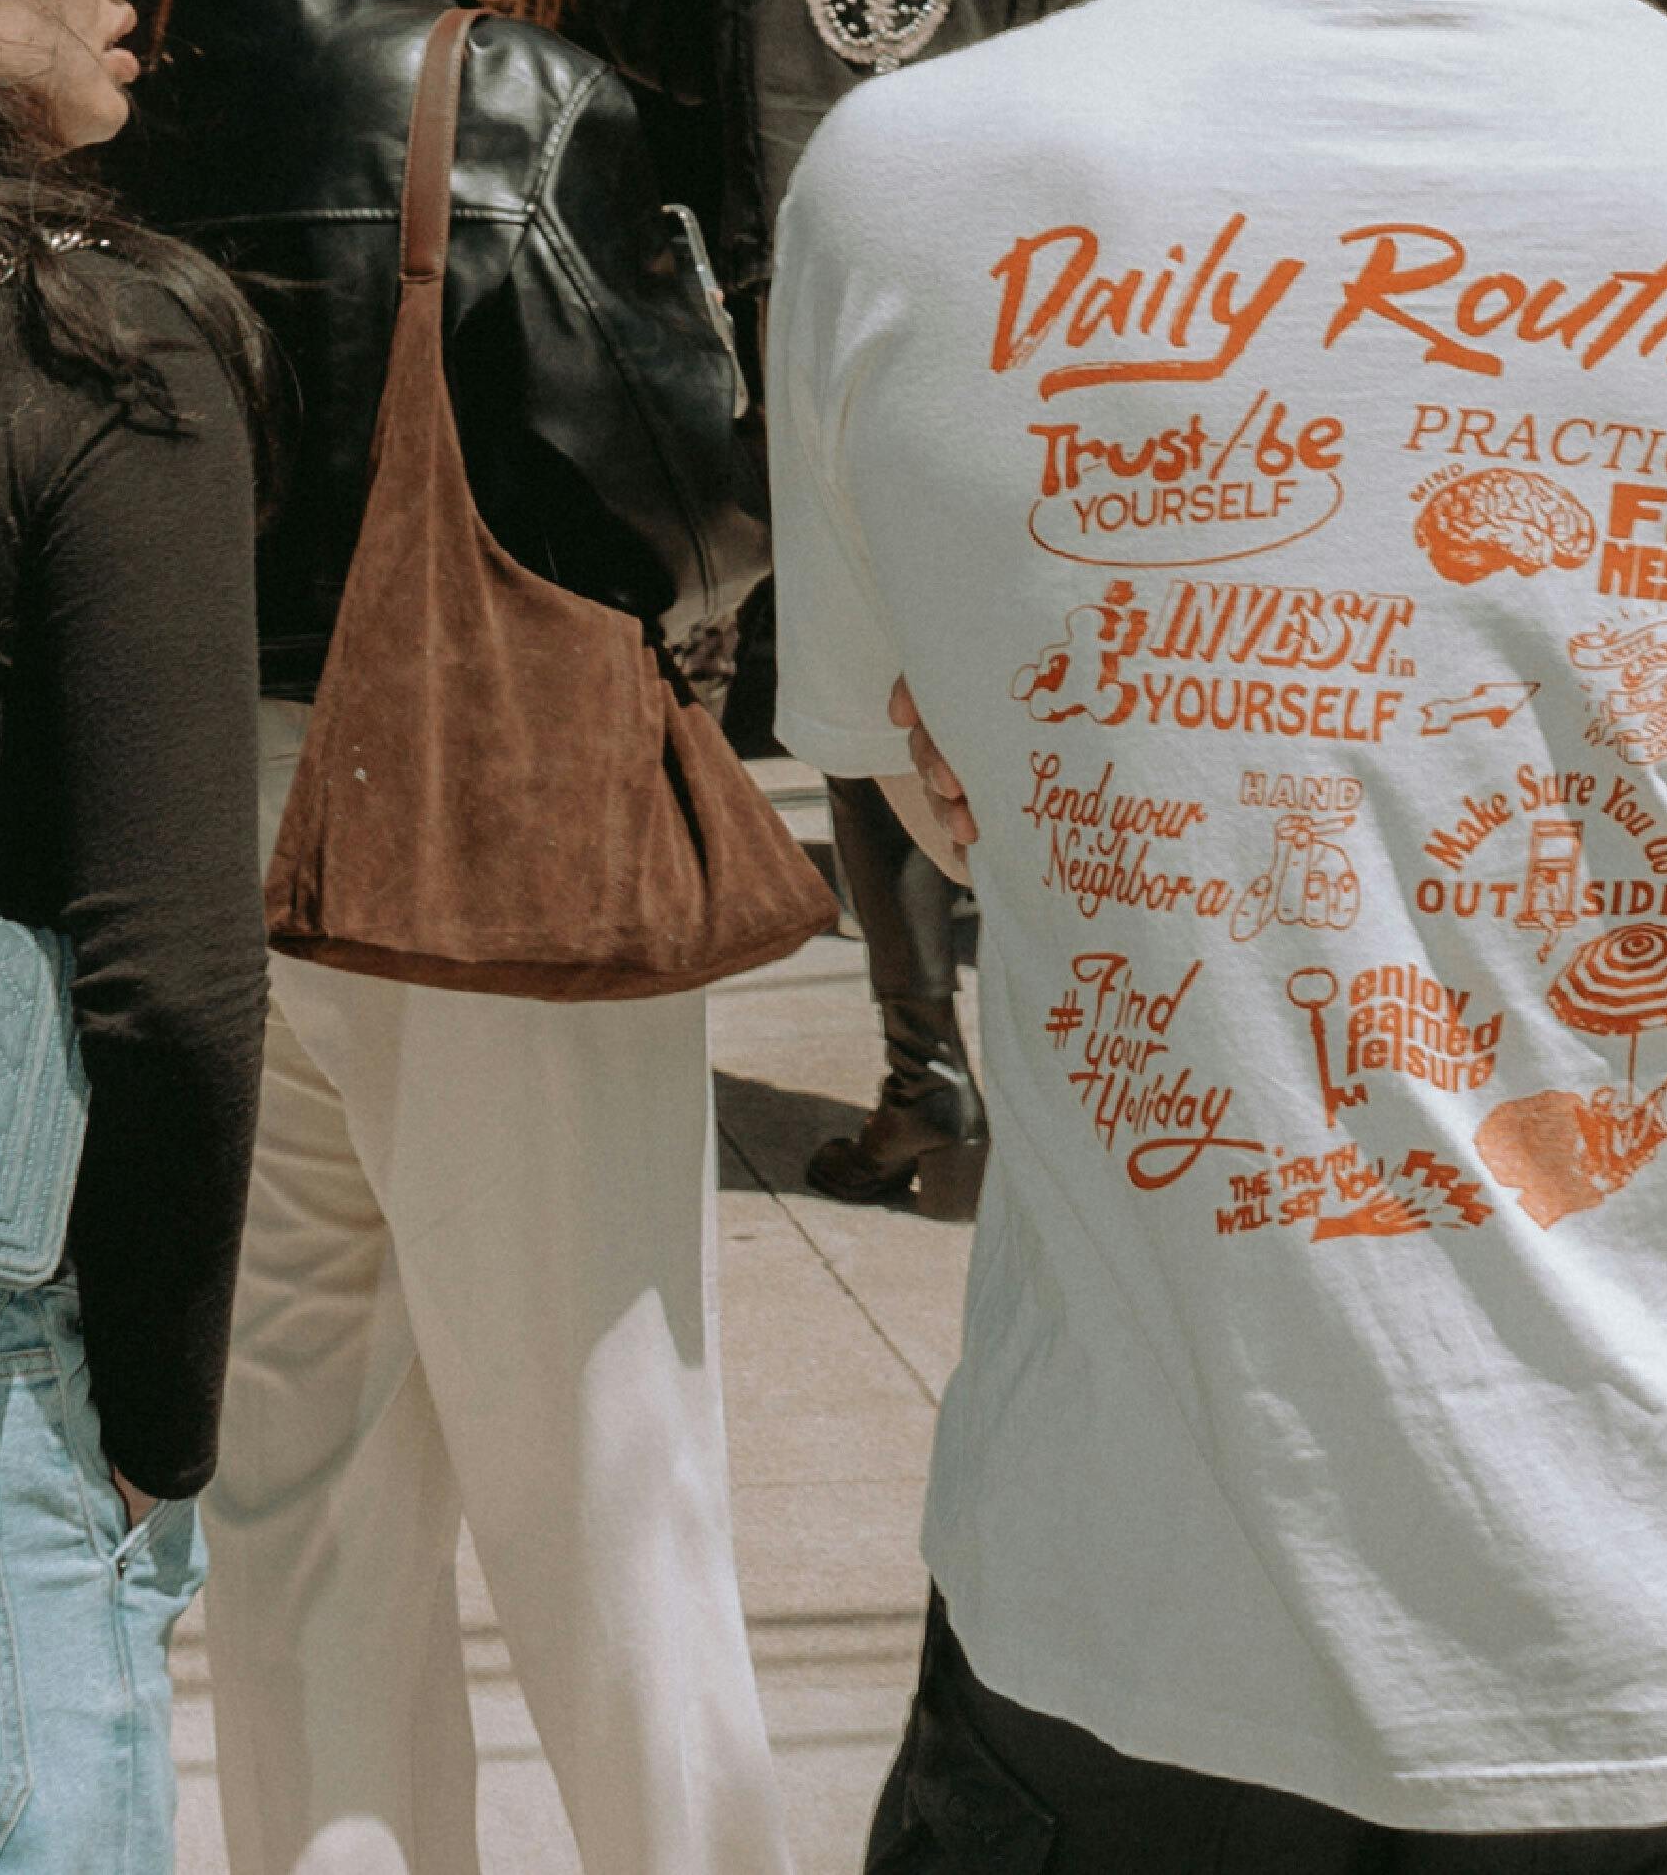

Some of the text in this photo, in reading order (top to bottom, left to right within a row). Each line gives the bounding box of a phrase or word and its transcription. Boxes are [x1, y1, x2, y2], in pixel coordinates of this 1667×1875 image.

[991, 212, 1306, 401] Daily
[1073, 479, 1299, 535] YOURSELF
[1410, 463, 1465, 502] MIND
[1148, 579, 1417, 677] INVEST in
[1142, 672, 1405, 745] YOURSELF
[1023, 751, 1207, 860] Lend your
[1239, 770, 1365, 813] HAND
[1424, 787, 1511, 872] Make
[1519, 763, 1597, 815] Sure
[1600, 775, 1660, 841] You
[1043, 822, 1195, 919] Neighbor
[1348, 962, 1471, 1027] enjoy
[1085, 1029, 1169, 1075] your
[1347, 1001, 1504, 1053] earned
[1346, 1032, 1499, 1094] leisure
[1229, 1171, 1272, 1203] THE
